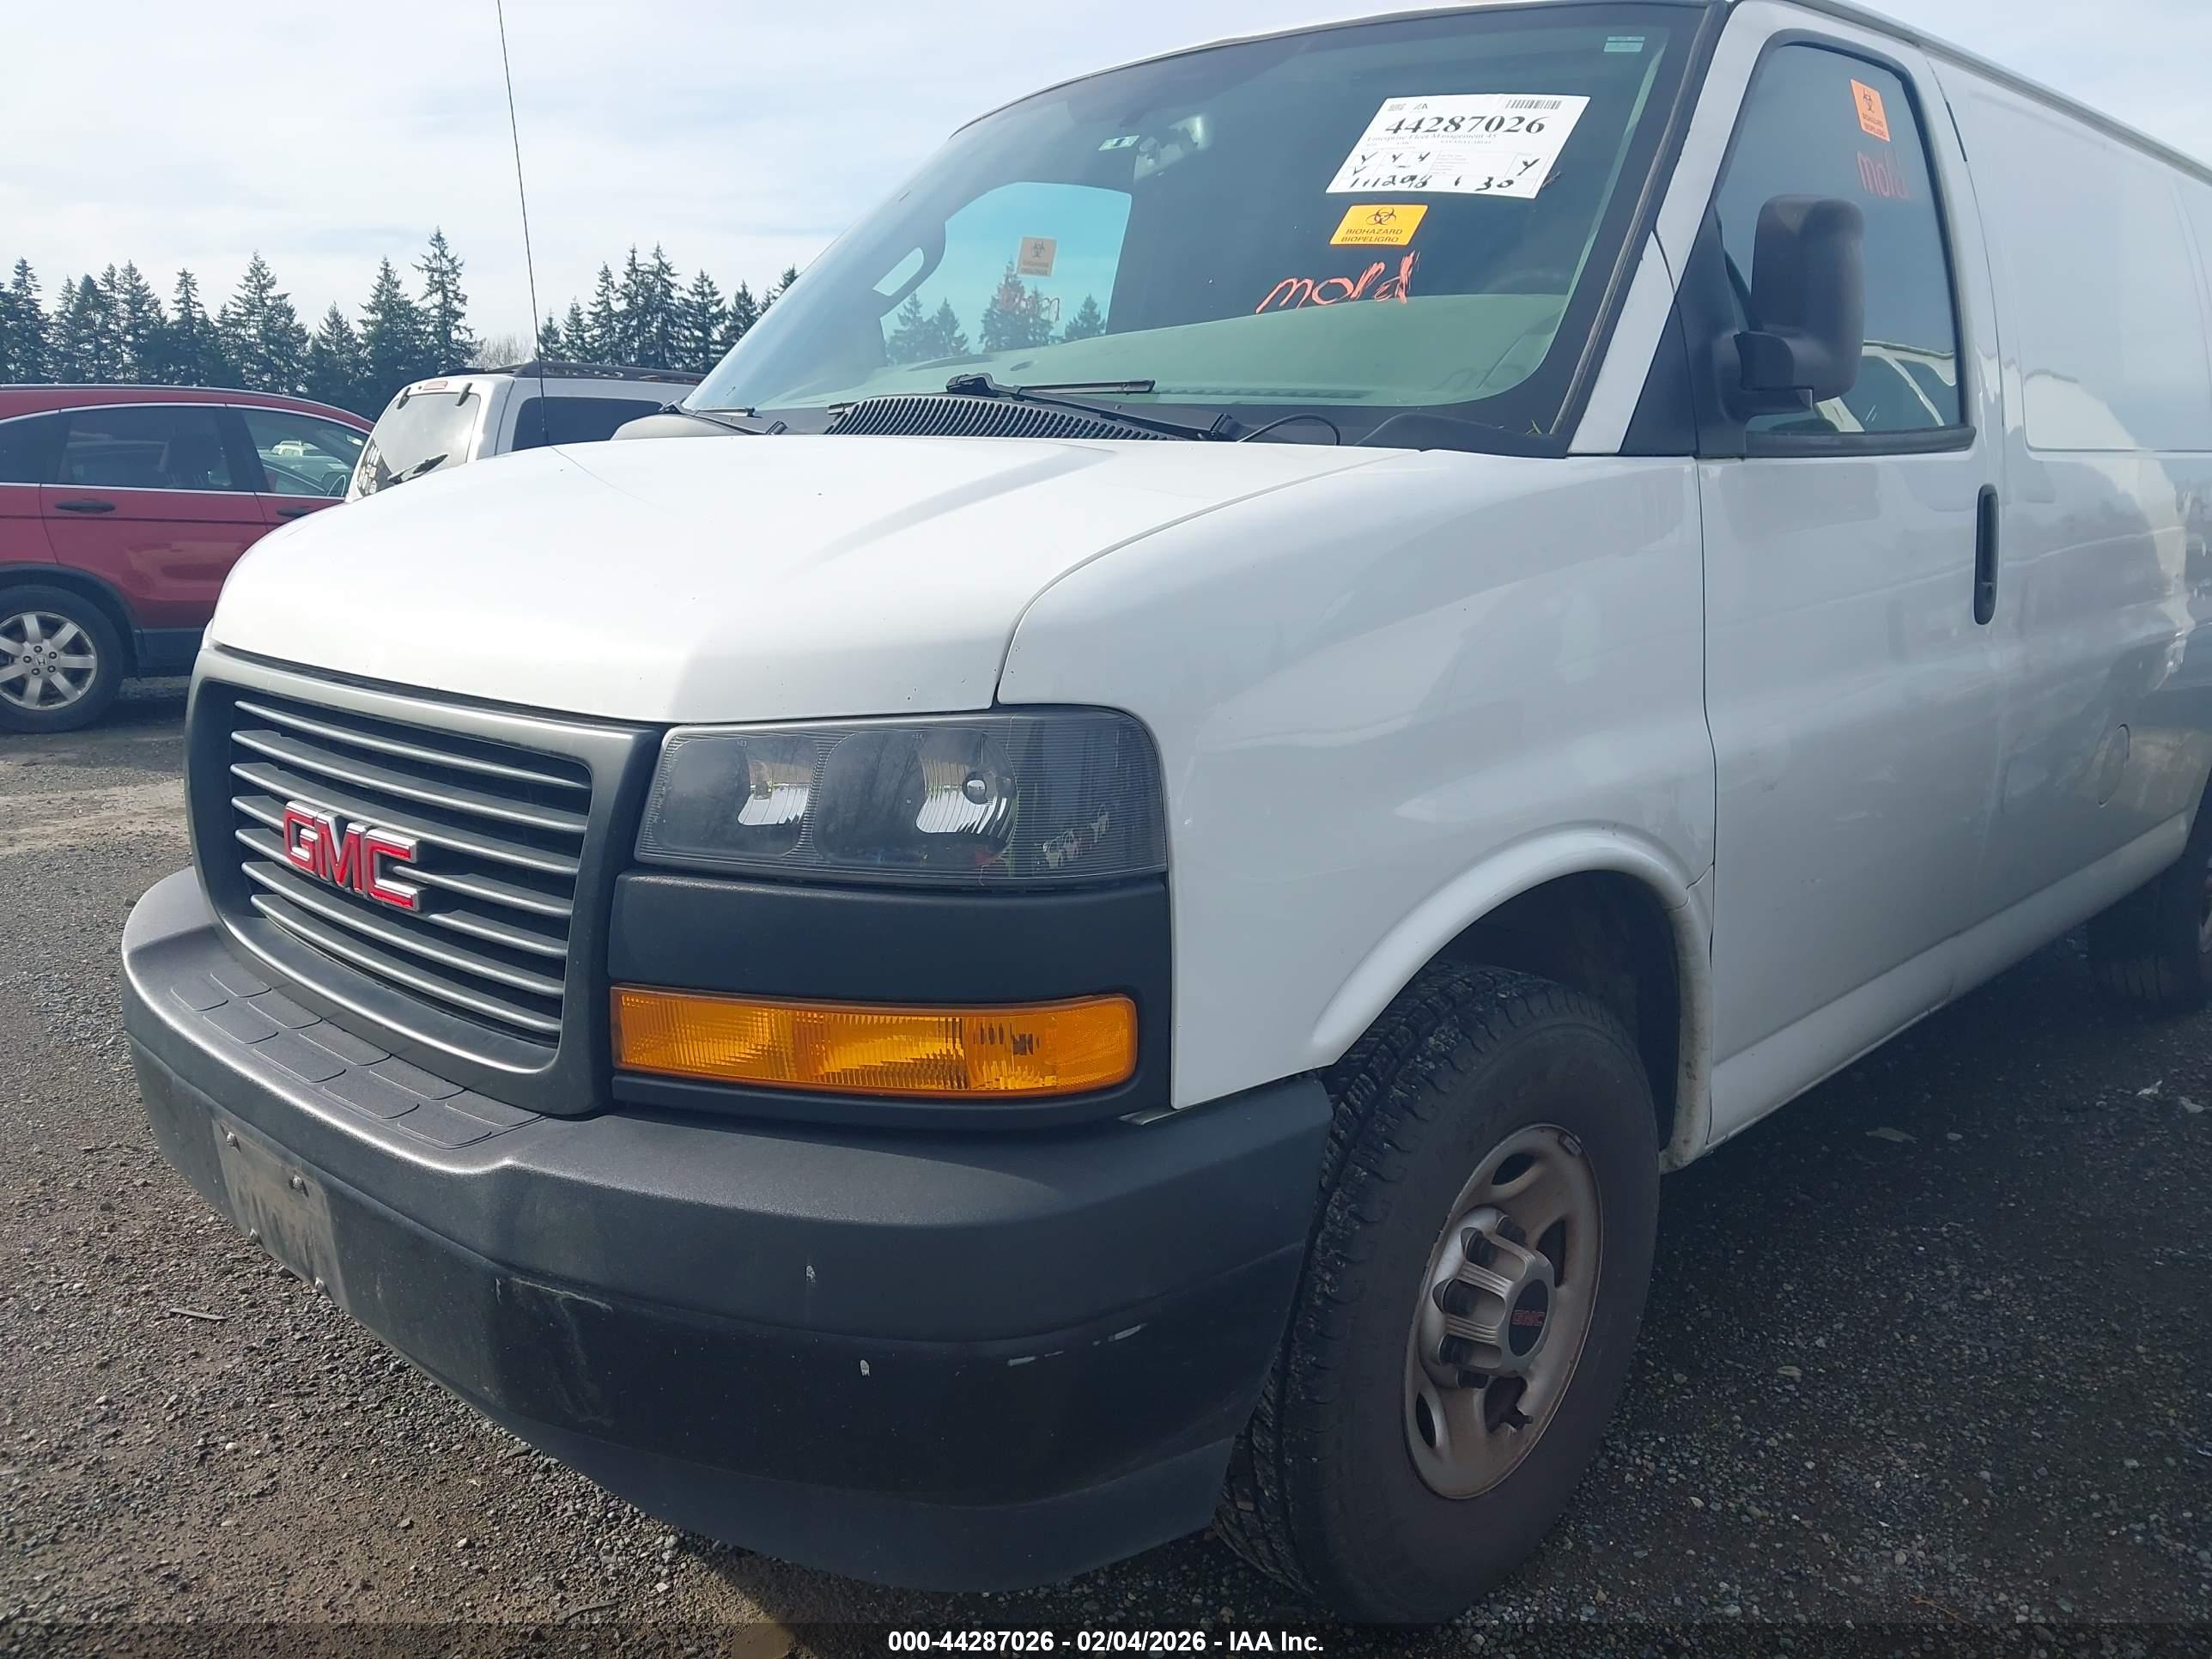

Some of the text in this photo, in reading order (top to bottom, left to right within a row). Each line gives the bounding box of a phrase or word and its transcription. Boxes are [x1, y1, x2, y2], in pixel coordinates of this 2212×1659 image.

[1384, 115, 1550, 135] 44287026
[1255, 250, 1420, 315] mold
[283, 799, 422, 912] GMC
[1511, 1309, 1546, 1327] GMC
